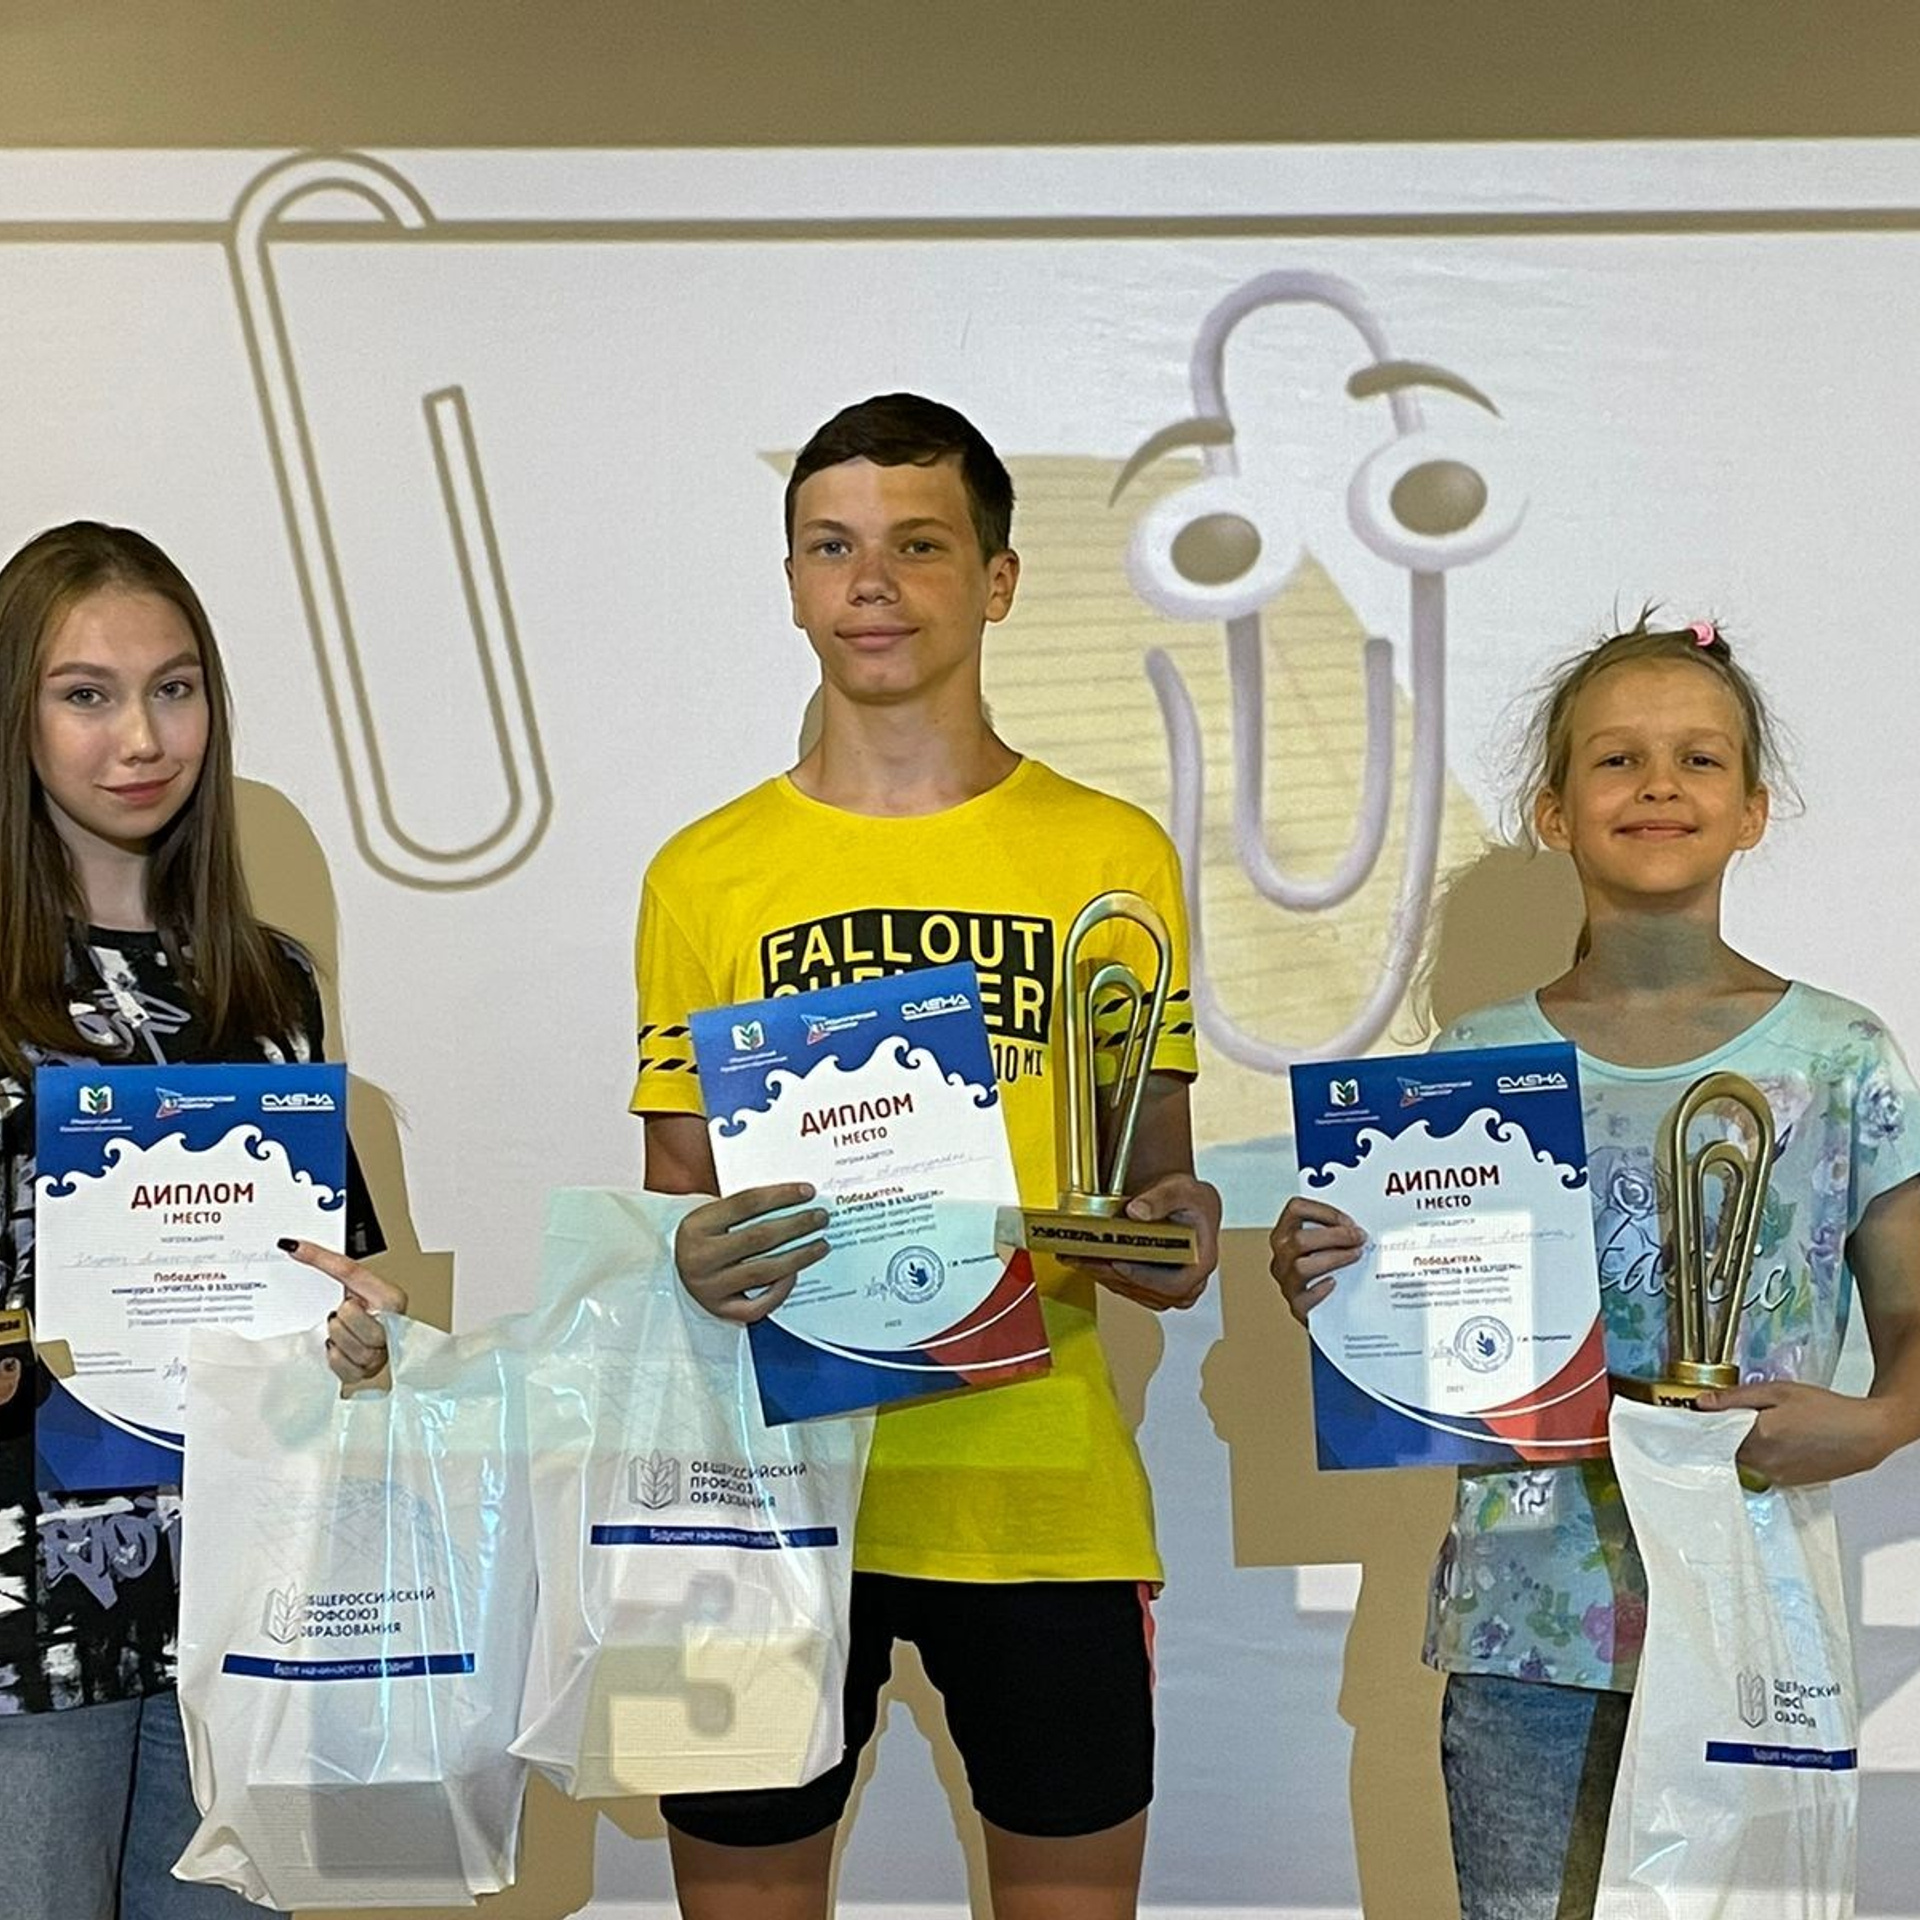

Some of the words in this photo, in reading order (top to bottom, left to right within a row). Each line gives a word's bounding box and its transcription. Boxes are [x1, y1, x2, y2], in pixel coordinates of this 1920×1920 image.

[767, 913, 1045, 984] FALLOUT
[799, 1092, 915, 1138] ДИПЛОМ
[841, 1126, 889, 1146] МЕСТО
[1385, 1164, 1500, 1197] ДИПЛОМ
[130, 1182, 254, 1209] ДИПЛОМ
[835, 1185, 904, 1206] Победитель
[1424, 1195, 1472, 1210] МЕСТО
[172, 1211, 222, 1225] МЕСТО
[1412, 1254, 1482, 1267] Победитель
[153, 1272, 228, 1283] Победитель
